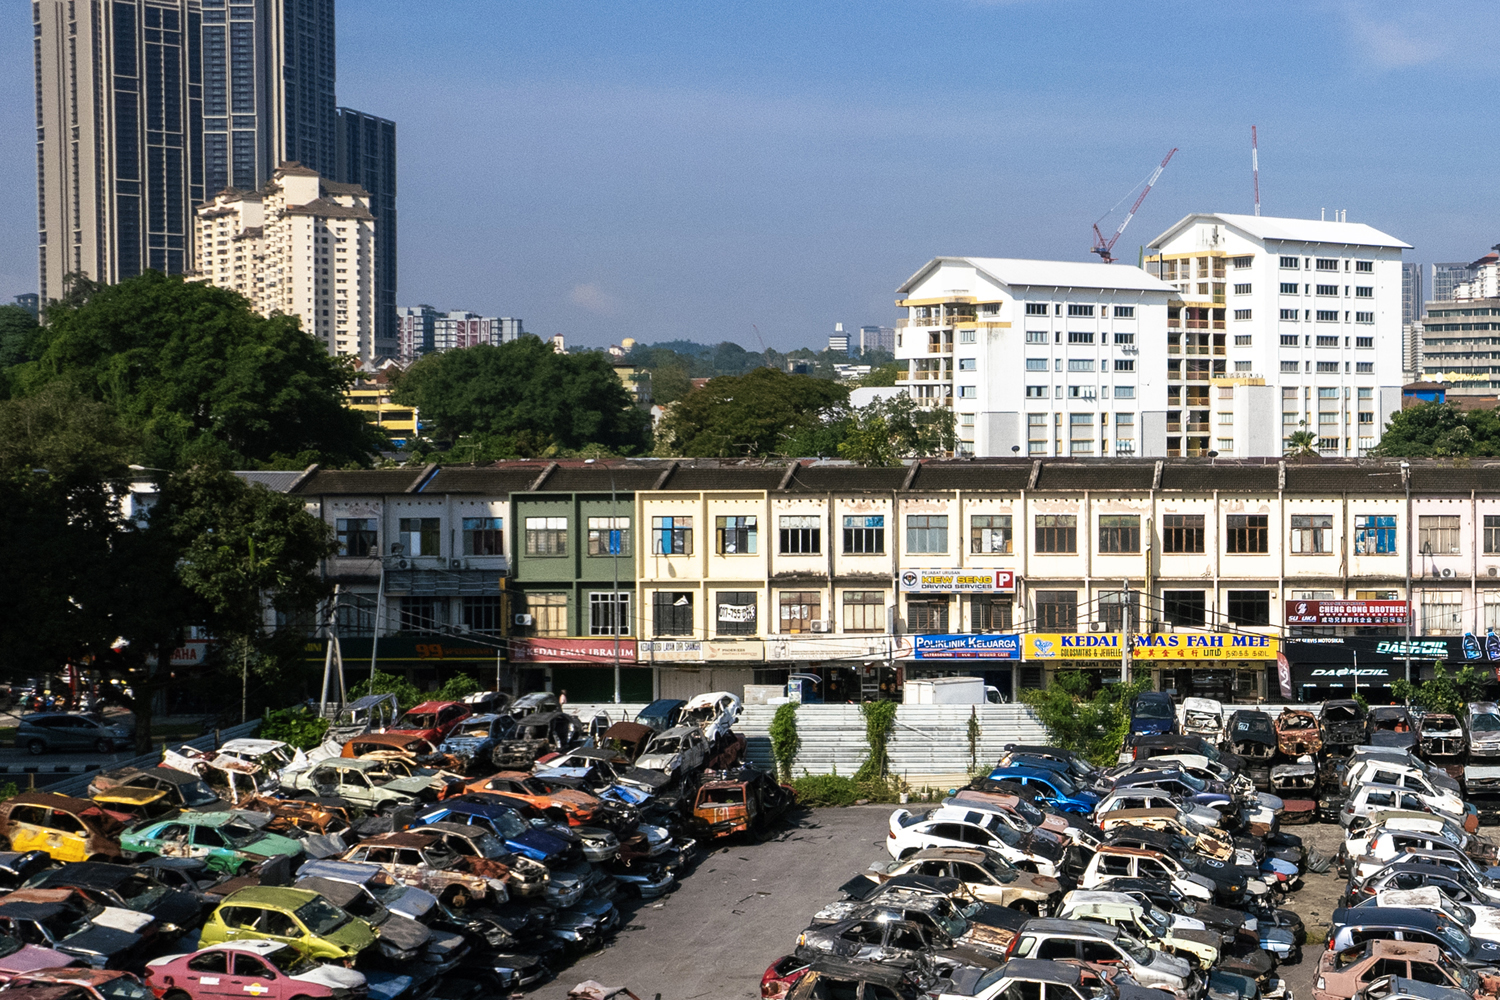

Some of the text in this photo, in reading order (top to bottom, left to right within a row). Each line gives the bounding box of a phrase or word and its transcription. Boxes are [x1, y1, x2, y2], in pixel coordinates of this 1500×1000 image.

[921, 576, 993, 584] KIEW SENG
[916, 637, 1017, 648] POLIKLINIK KELUARGA
[1060, 635, 1270, 647] KEDAI MAS FAH MEE
[415, 643, 443, 659] 99
[527, 648, 557, 656] KEDAI
[560, 648, 586, 656] EMAS
[1099, 648, 1123, 657] JEWELLE
